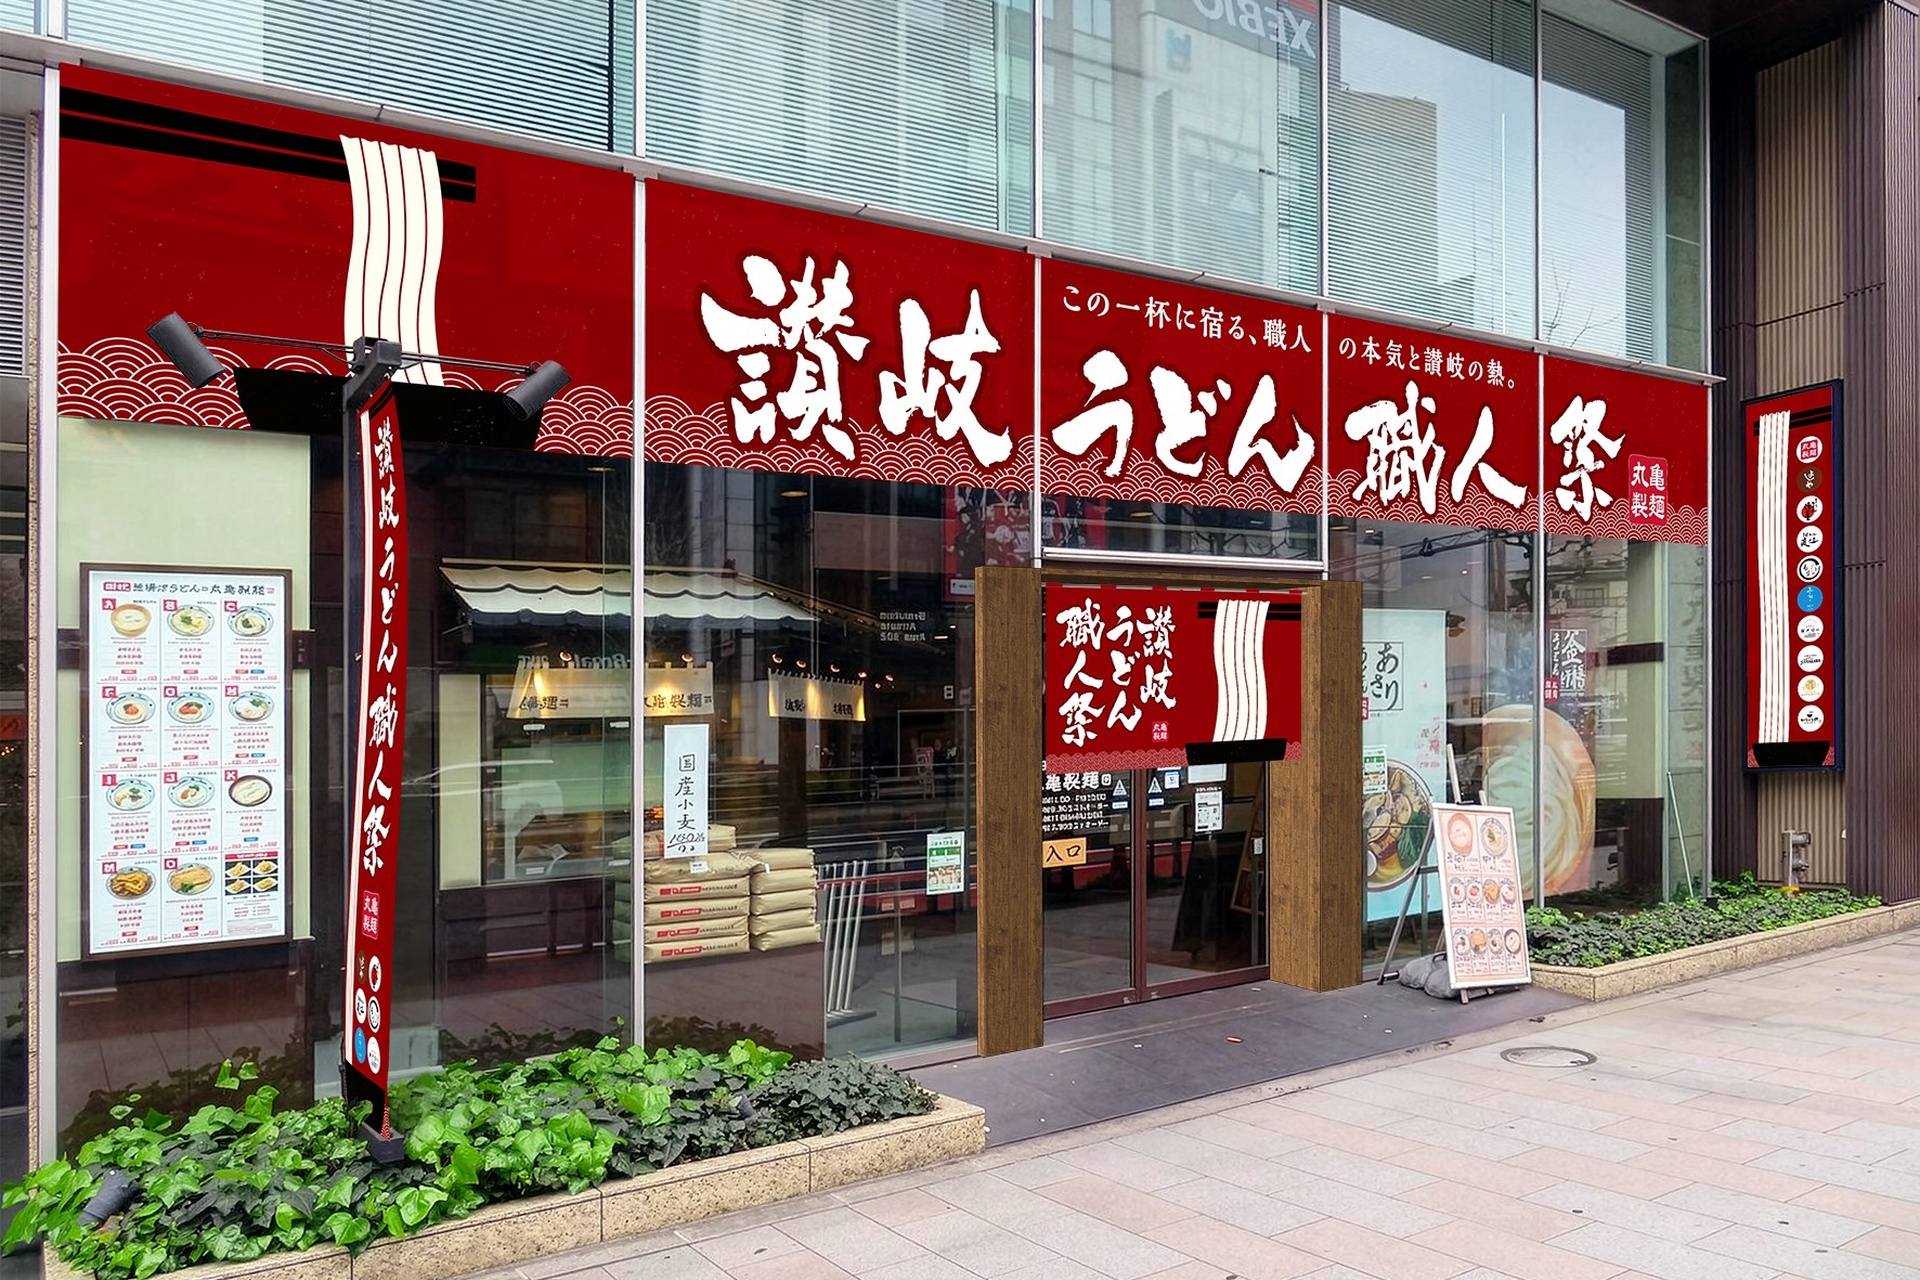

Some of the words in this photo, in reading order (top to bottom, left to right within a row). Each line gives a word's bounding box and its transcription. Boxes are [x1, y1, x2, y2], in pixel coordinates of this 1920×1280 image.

[1056, 597, 1105, 747] 職人祭
[1106, 606, 1142, 731] うどん
[1136, 605, 1177, 709] 讃岐
[1370, 642, 1399, 710] あさり
[1046, 845, 1081, 862] 入口
